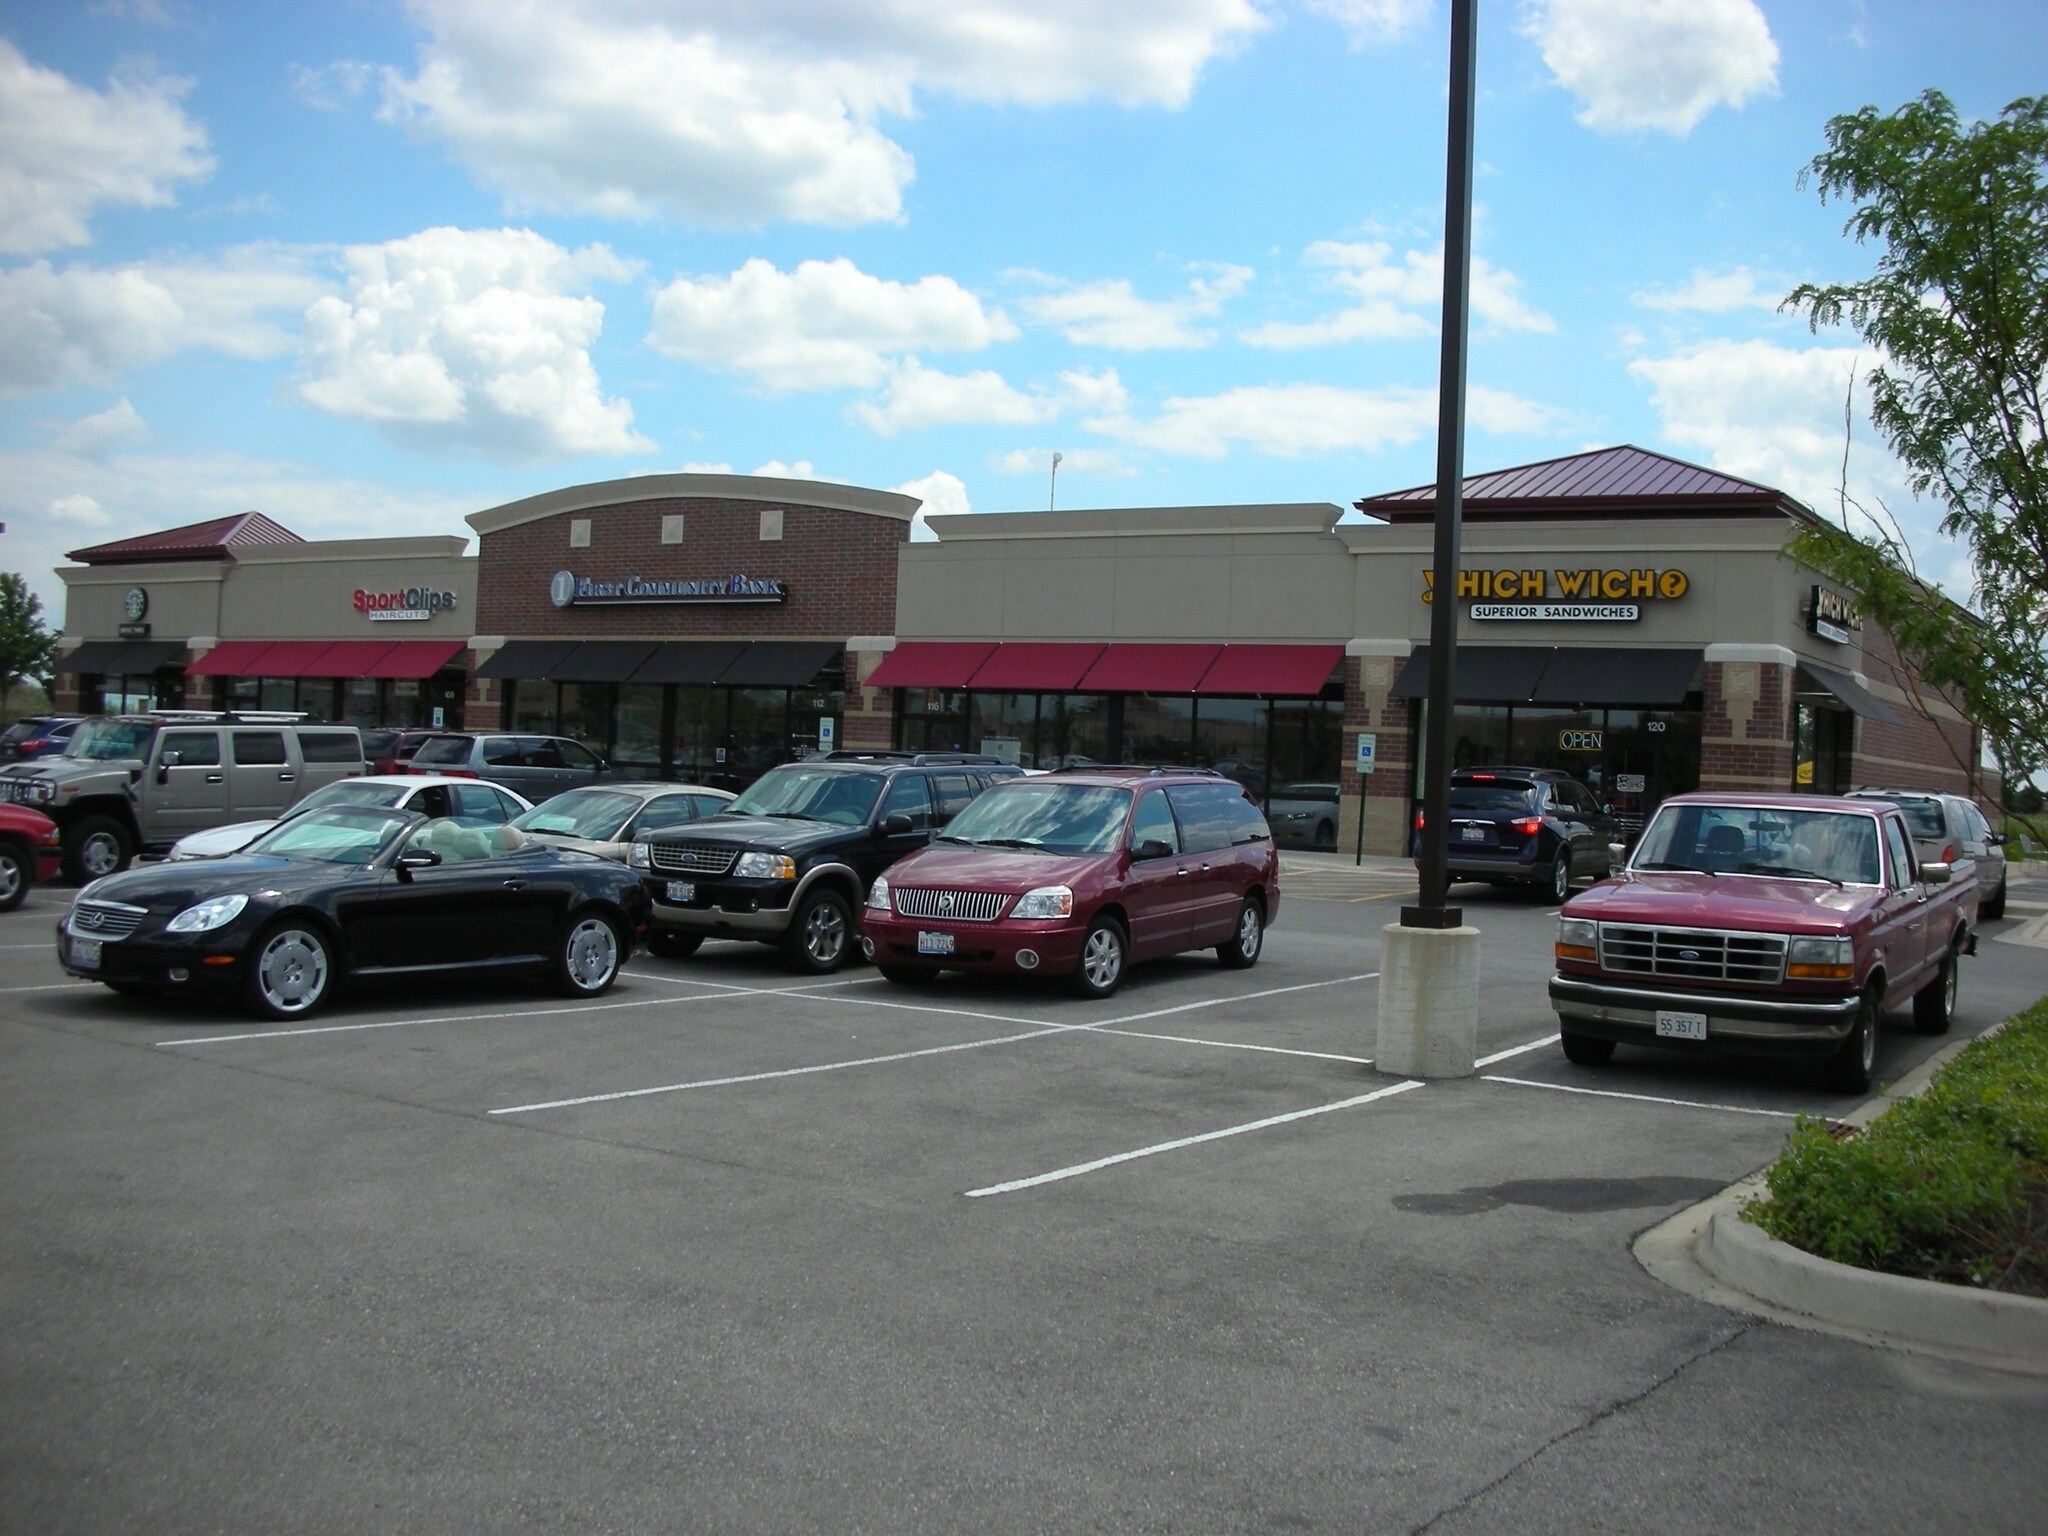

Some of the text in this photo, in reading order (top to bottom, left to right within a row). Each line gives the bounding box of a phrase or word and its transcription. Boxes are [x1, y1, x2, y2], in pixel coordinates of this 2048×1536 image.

[729, 573, 781, 594] BANK
[370, 611, 428, 619] HAIRCUTS
[1474, 606, 1634, 619] SUPERIOR SANDWICHES
[813, 699, 825, 707] 112
[927, 702, 939, 711] 116
[1647, 721, 1666, 732] 120
[1561, 731, 1602, 749] OPEN
[1661, 1018, 1701, 1034] 55 357 T
